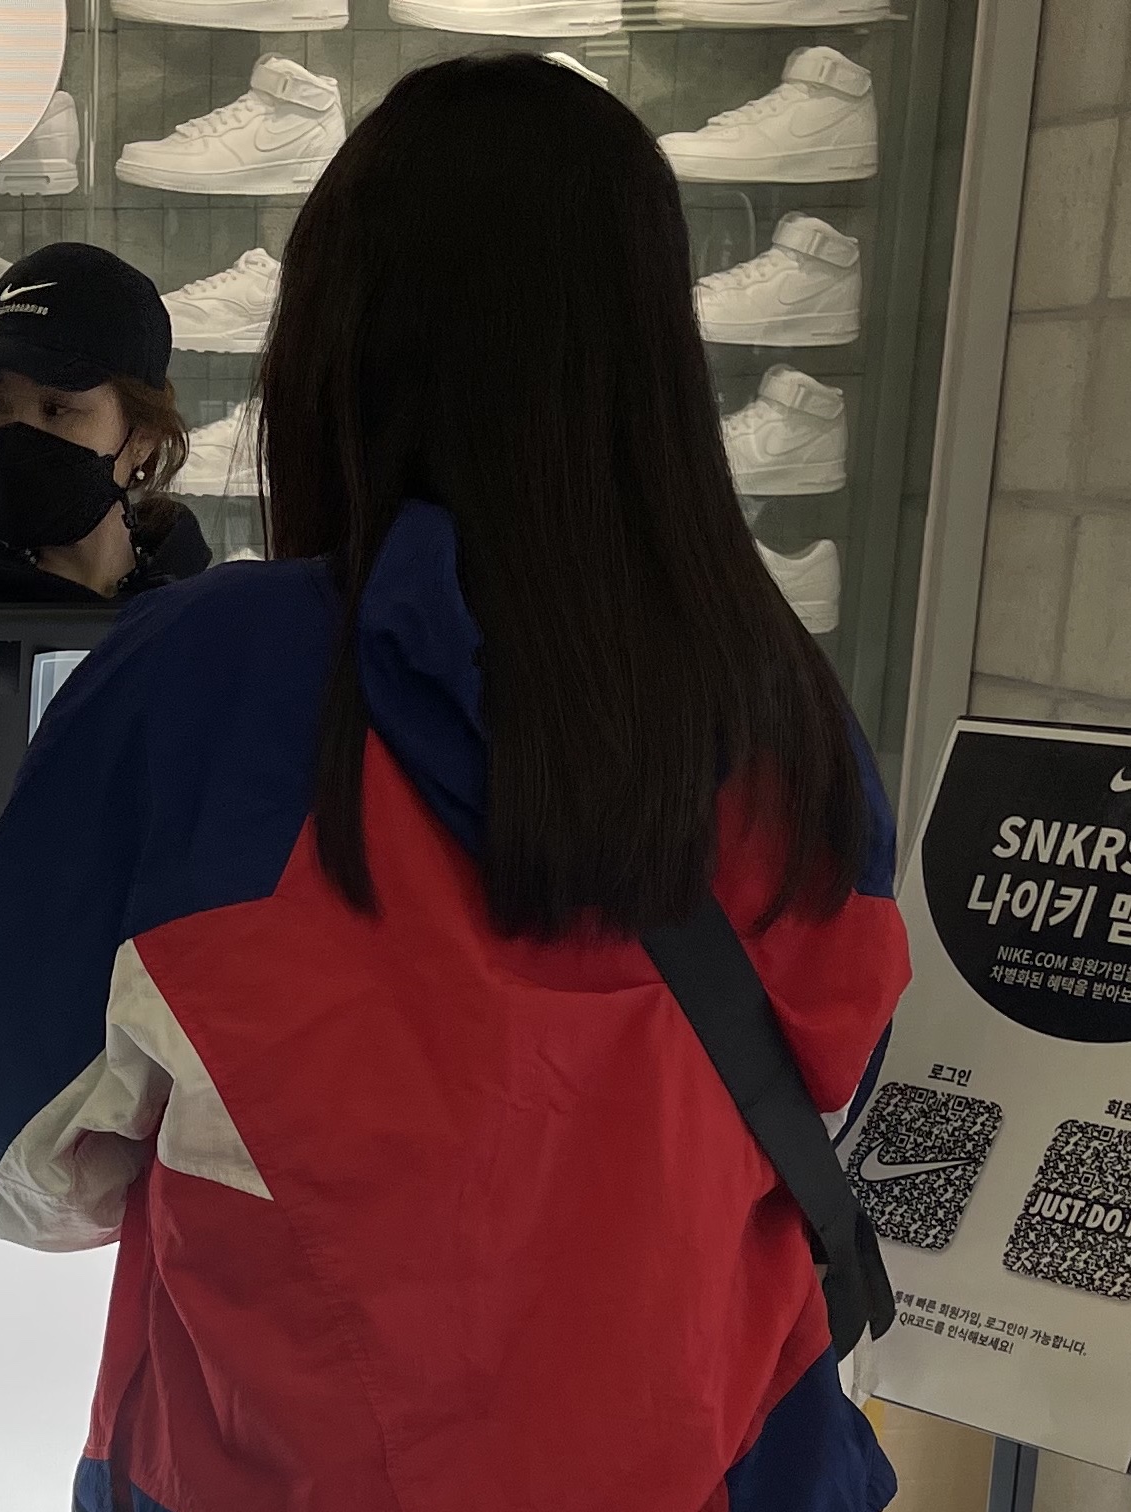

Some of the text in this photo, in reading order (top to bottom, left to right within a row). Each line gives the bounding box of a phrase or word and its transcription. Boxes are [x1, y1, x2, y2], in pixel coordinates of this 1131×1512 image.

[967, 873, 1099, 939] 나이키
[997, 945, 1069, 971] NIKE.COM
[989, 965, 1044, 989] 차별화된
[1047, 974, 1088, 998] 혜택을
[928, 1064, 972, 1087] 로그인
[1028, 1191, 1086, 1224] JUST
[1085, 1204, 1123, 1233] DO
[899, 1312, 1015, 1355] QR코드를 인식해보세요!
[915, 1297, 937, 1314] 빠른
[938, 1302, 982, 1328] 회원가입,
[984, 1316, 1028, 1339] 로그인이
[1030, 1328, 1087, 1357] 가능합니다.
